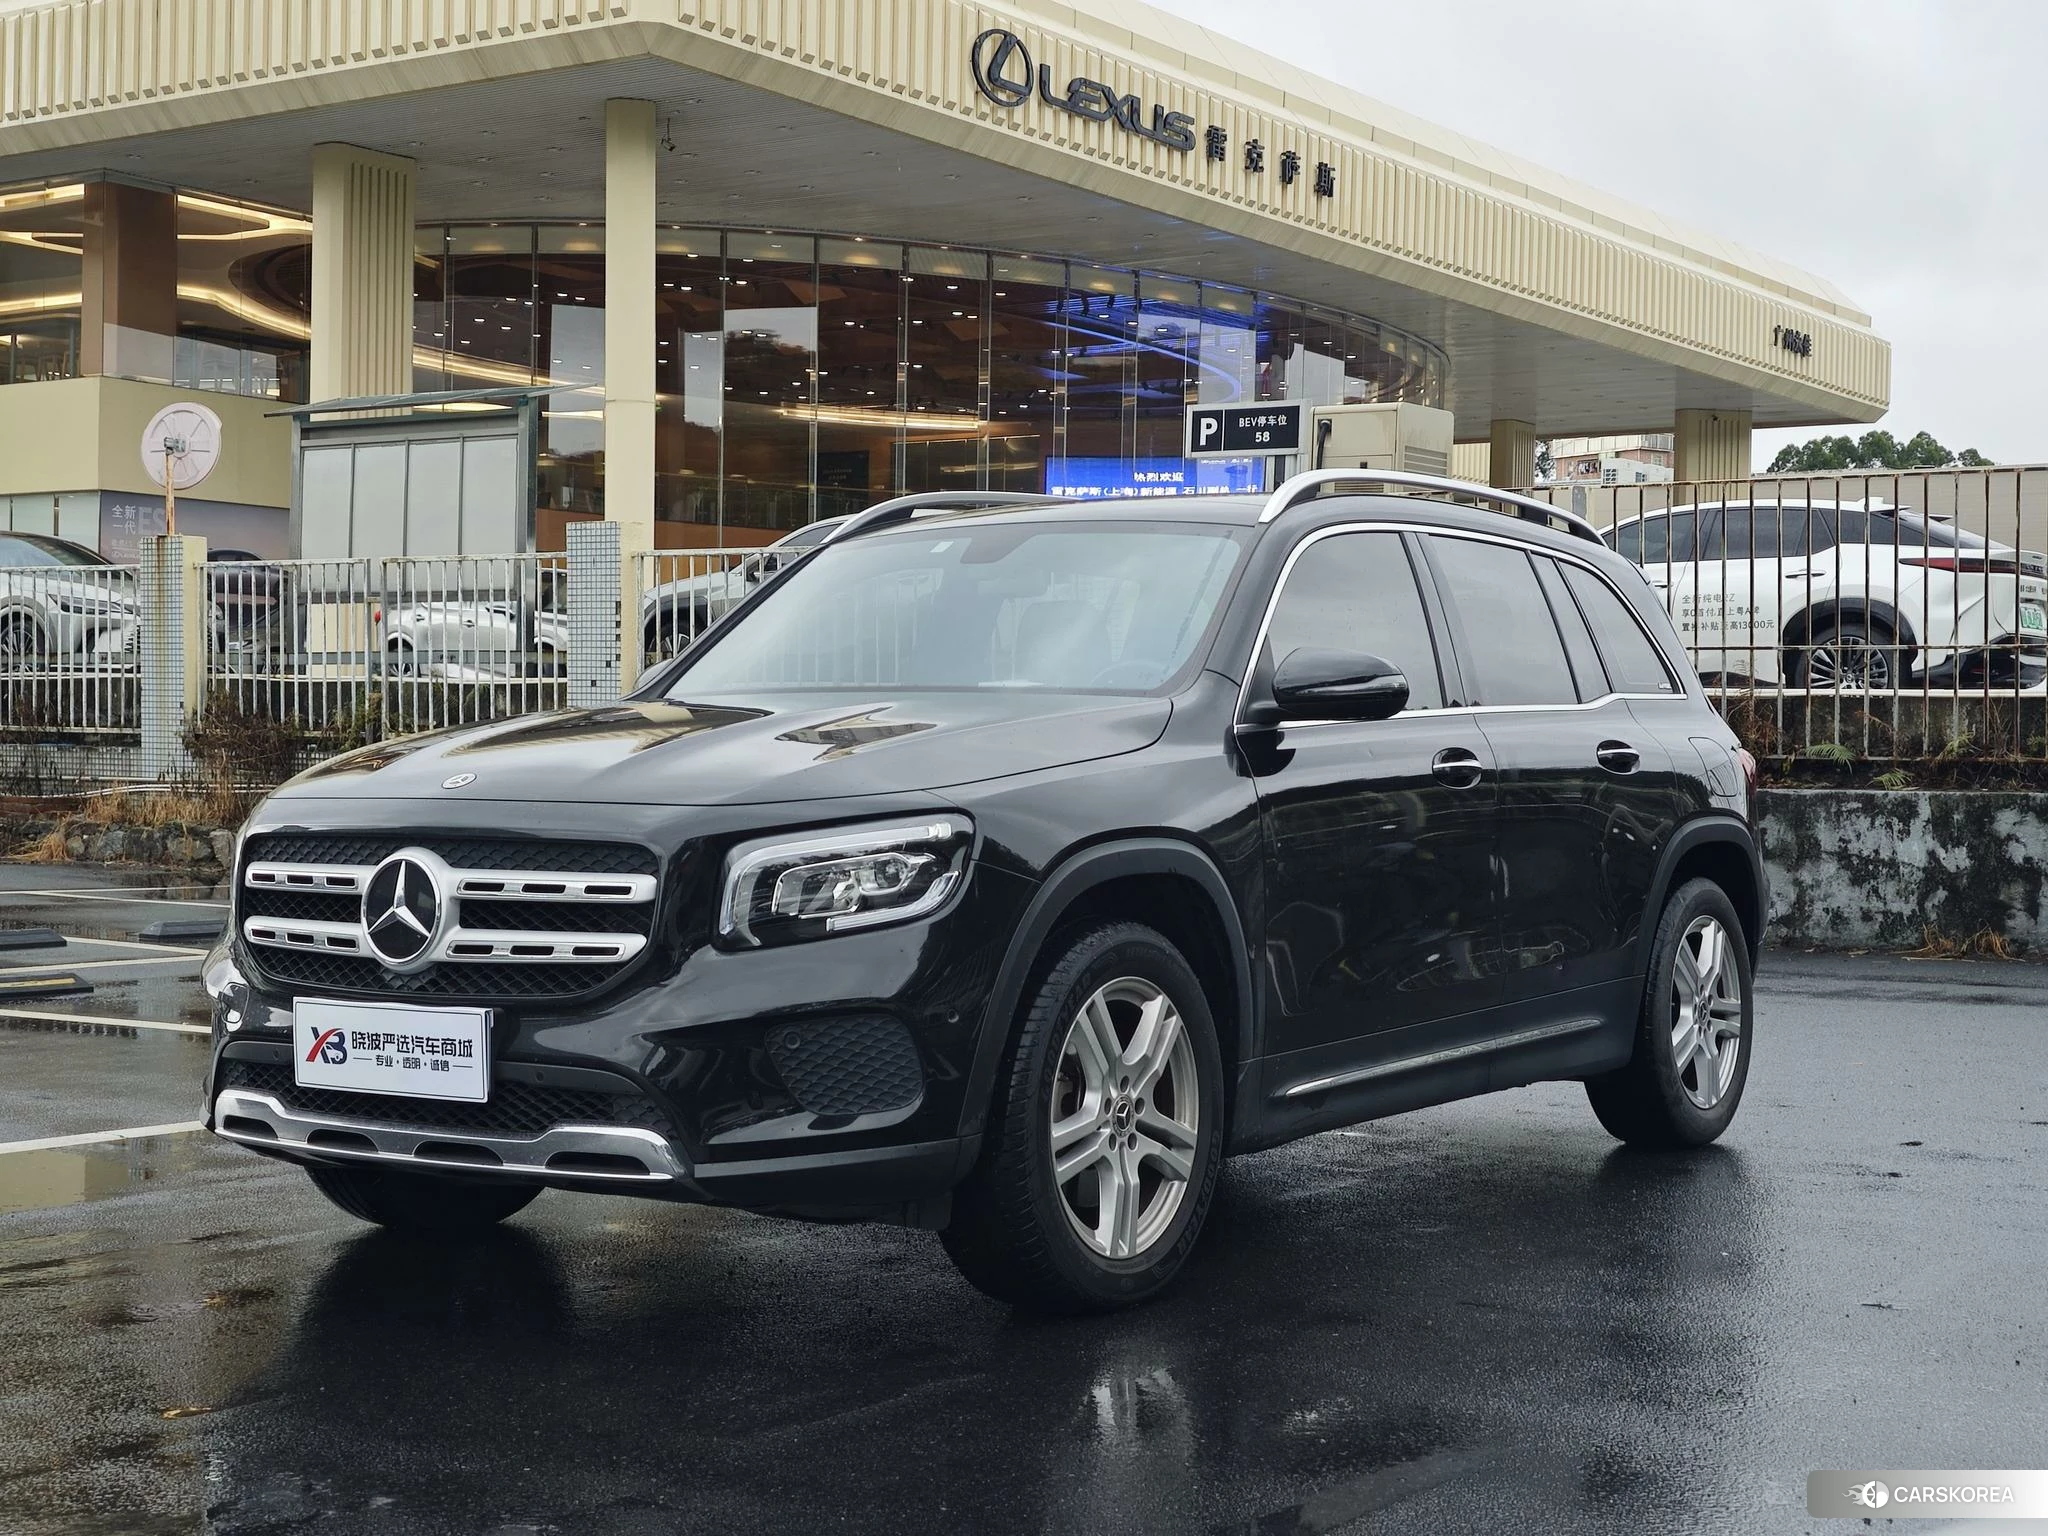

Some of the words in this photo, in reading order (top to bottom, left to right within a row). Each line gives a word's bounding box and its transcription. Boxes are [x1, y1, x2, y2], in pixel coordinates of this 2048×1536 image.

[1039, 63, 1196, 152] LEXUS
[1206, 125, 1336, 198] 雷克萨斯
[1239, 415, 1288, 428] BEV停车位
[1200, 418, 1218, 446] P
[1255, 431, 1270, 442] 58
[1134, 472, 1184, 482] 热烈欢迎
[111, 504, 136, 519] 全新
[112, 520, 136, 536] 一代
[351, 1031, 474, 1058] 晓波严选汽车商城
